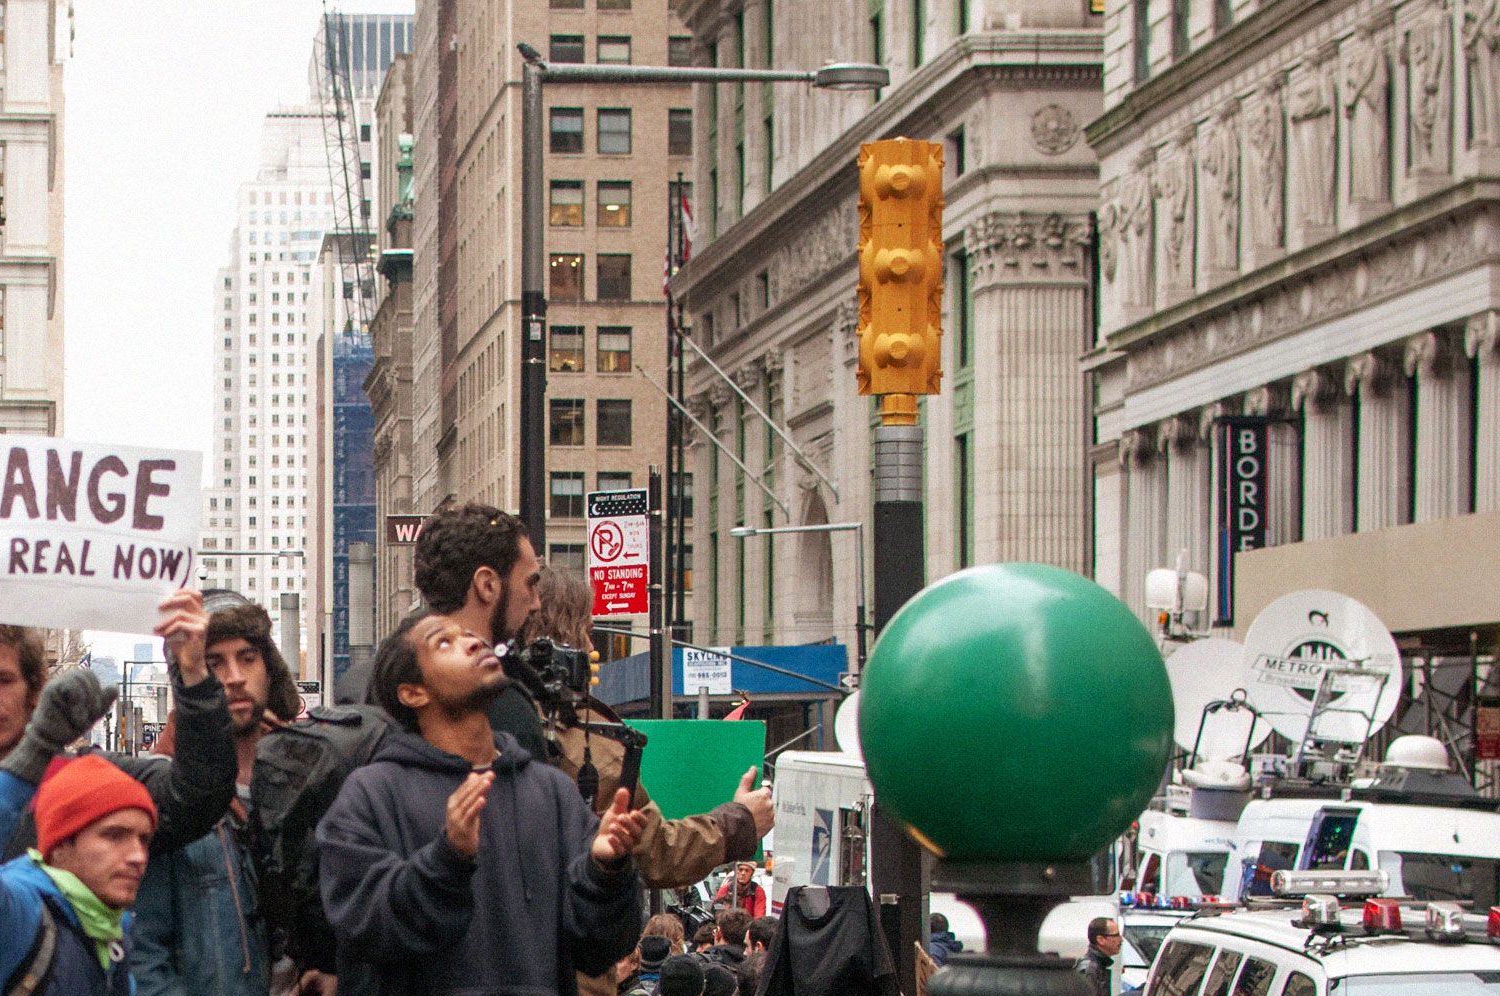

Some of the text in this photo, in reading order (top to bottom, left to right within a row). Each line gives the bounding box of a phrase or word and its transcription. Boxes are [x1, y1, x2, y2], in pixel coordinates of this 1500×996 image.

[8, 537, 96, 577] REAL
[113, 543, 194, 590] NOW)
[594, 568, 644, 581] NO STANDING
